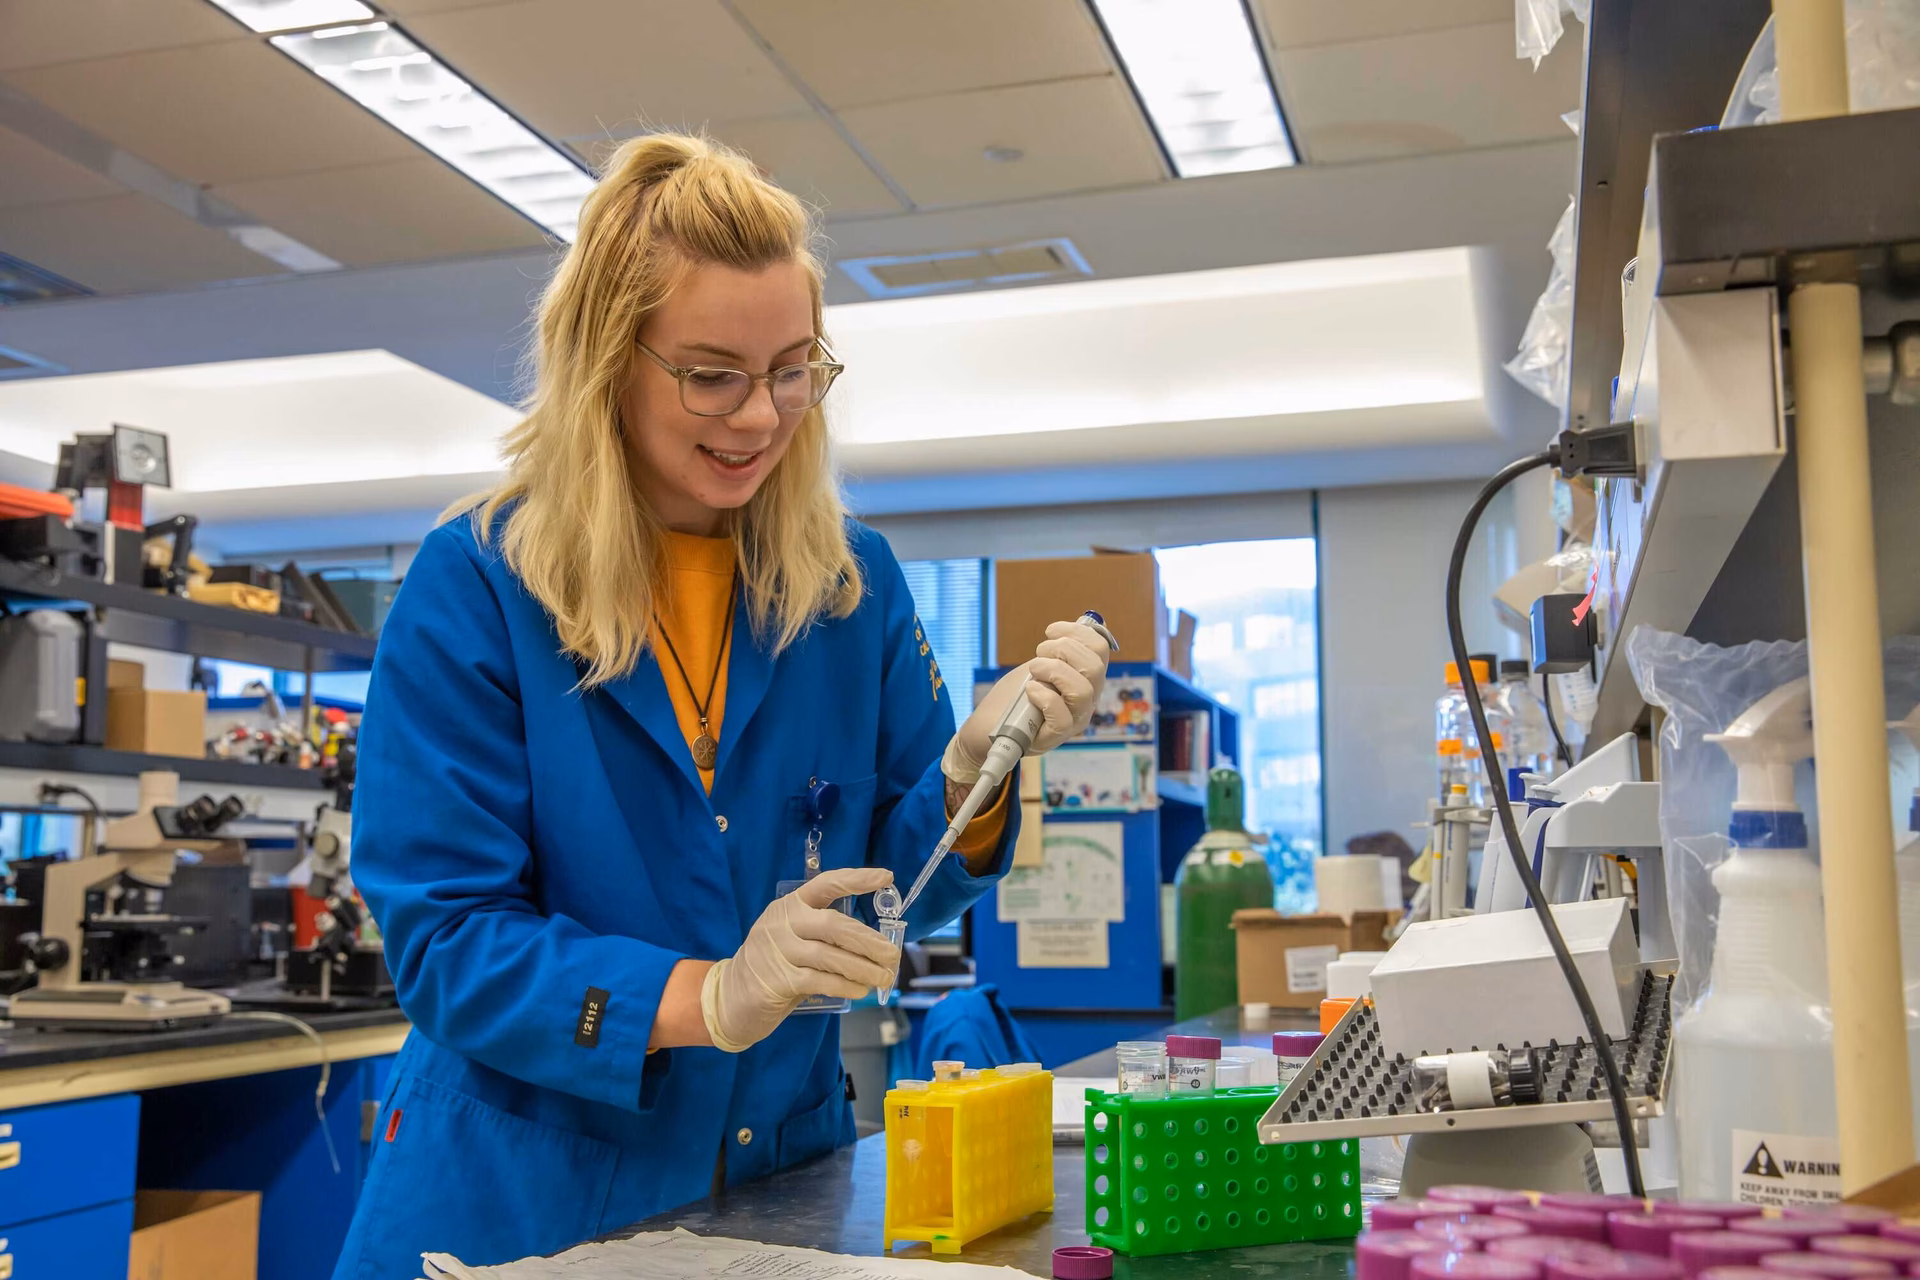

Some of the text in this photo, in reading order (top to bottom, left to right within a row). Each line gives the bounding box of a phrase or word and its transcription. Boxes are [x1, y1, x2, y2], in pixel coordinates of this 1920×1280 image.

[1783, 1160, 1841, 1177] WARNIN
[1741, 1183, 1763, 1192] KEEP
[1766, 1186, 1790, 1196] AWAY
[1793, 1188, 1818, 1199] FROM
